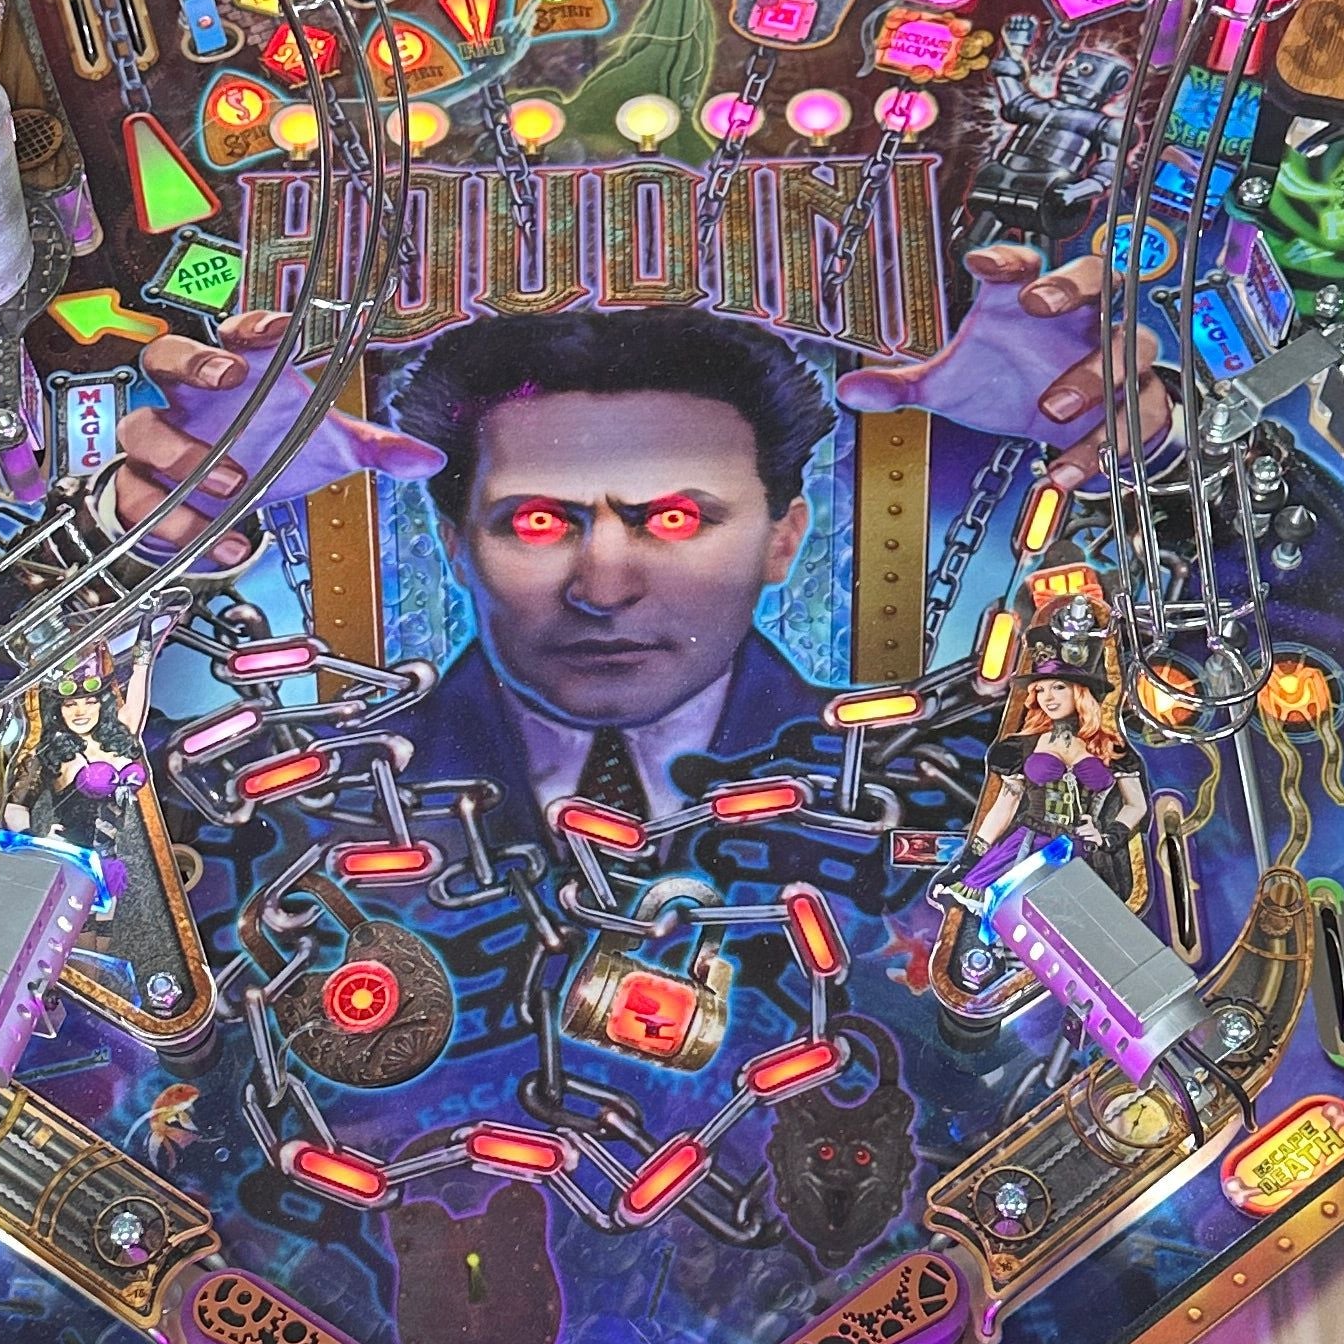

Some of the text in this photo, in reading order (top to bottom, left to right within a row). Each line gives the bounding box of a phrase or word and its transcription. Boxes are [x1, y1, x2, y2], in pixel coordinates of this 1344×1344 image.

[768, 4, 798, 25] 2X
[177, 255, 229, 284] ADD
[179, 268, 236, 296] TIME
[237, 157, 949, 370] HOUDINI
[77, 388, 102, 468] MAGIC
[1251, 1119, 1320, 1179] ESCAPE
